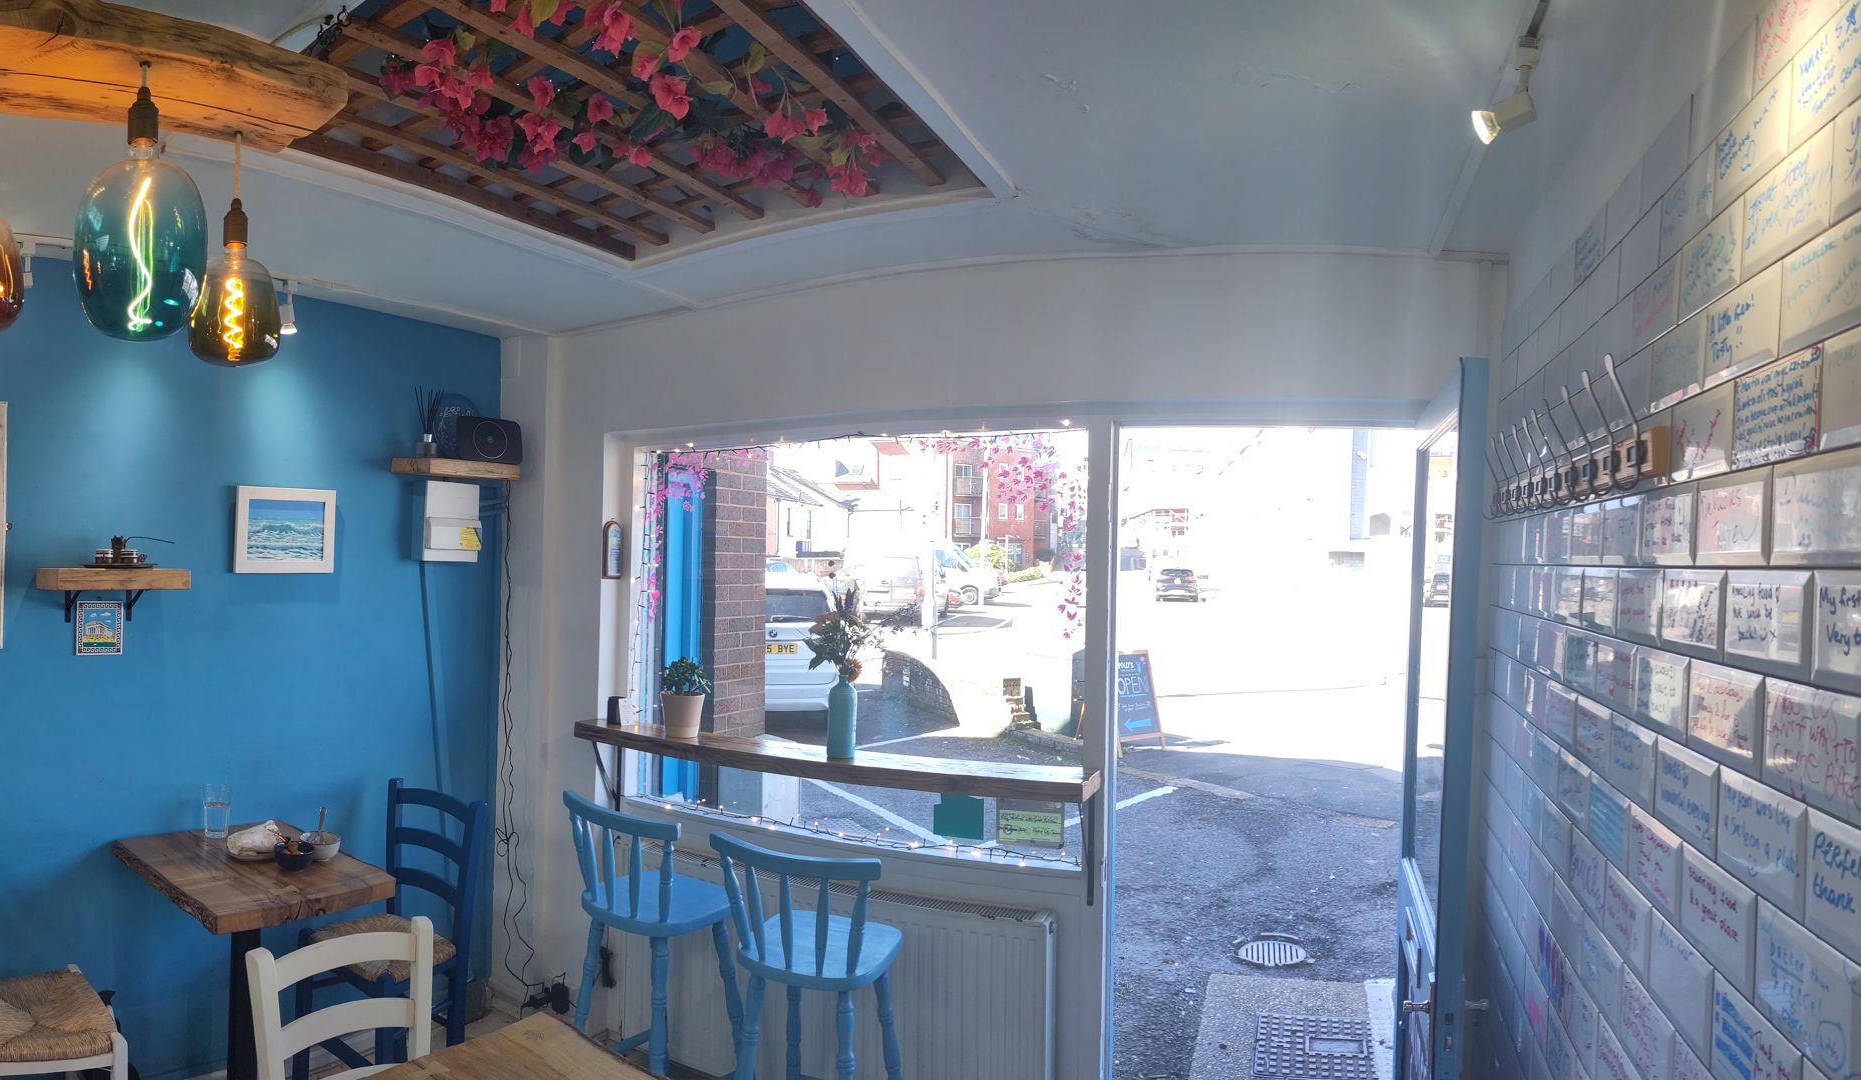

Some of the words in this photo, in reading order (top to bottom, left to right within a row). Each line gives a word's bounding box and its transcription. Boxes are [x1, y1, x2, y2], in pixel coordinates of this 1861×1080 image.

[1819, 586, 1837, 615] My
[778, 644, 795, 653] BYE
[1826, 622, 1851, 656] Very
[1117, 676, 1150, 695] OPEN
[1812, 872, 1857, 915] thank
